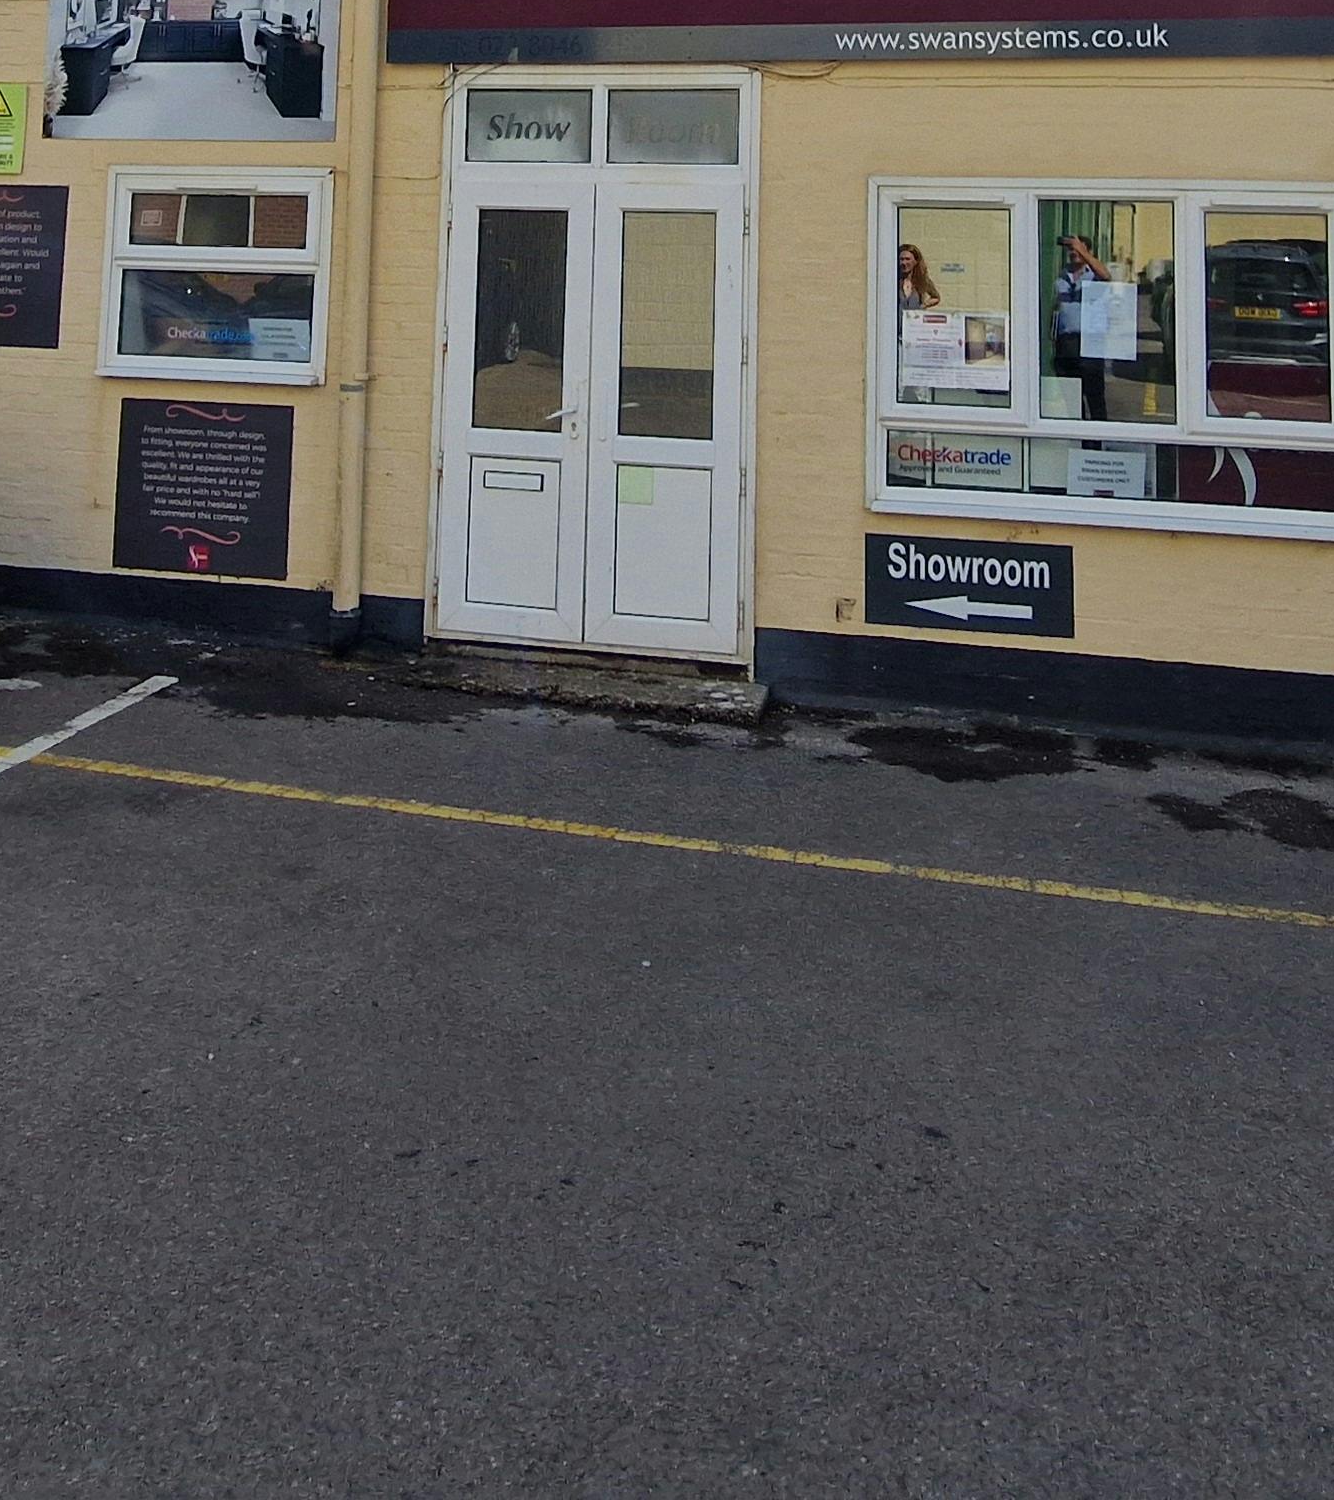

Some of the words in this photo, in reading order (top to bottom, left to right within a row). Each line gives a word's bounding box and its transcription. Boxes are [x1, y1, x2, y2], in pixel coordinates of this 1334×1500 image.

[835, 22, 1168, 55] www.swansystems.co.uk
[486, 113, 572, 142] Show
[5, 222, 32, 232] design
[22, 236, 37, 244] and
[23, 249, 49, 257] Would
[0, 262, 22, 270] again
[24, 262, 40, 270] and
[14, 274, 22, 282] to
[207, 429, 237, 439] through
[175, 440, 209, 449] everyone
[210, 441, 250, 451] concerned
[206, 452, 232, 461] thrilled
[234, 453, 250, 463] with
[252, 455, 265, 464] the
[898, 443, 1012, 466] Checkatrade
[179, 463, 194, 471] and
[195, 465, 240, 475] appearance
[250, 467, 264, 476] our
[937, 464, 953, 474] and
[954, 465, 1002, 476] Guaranteed
[143, 473, 176, 482] beautiful
[178, 474, 217, 485] wardrobes
[218, 476, 227, 485] all
[245, 480, 261, 489] very
[142, 483, 154, 492] fair
[156, 485, 175, 494] price
[176, 486, 191, 495] and
[192, 487, 209, 495] with
[168, 498, 191, 506] would
[193, 499, 206, 507] not
[207, 499, 238, 509] hesitate
[149, 509, 196, 518] recommend
[197, 511, 211, 520] this
[887, 541, 1051, 589] Showroom
